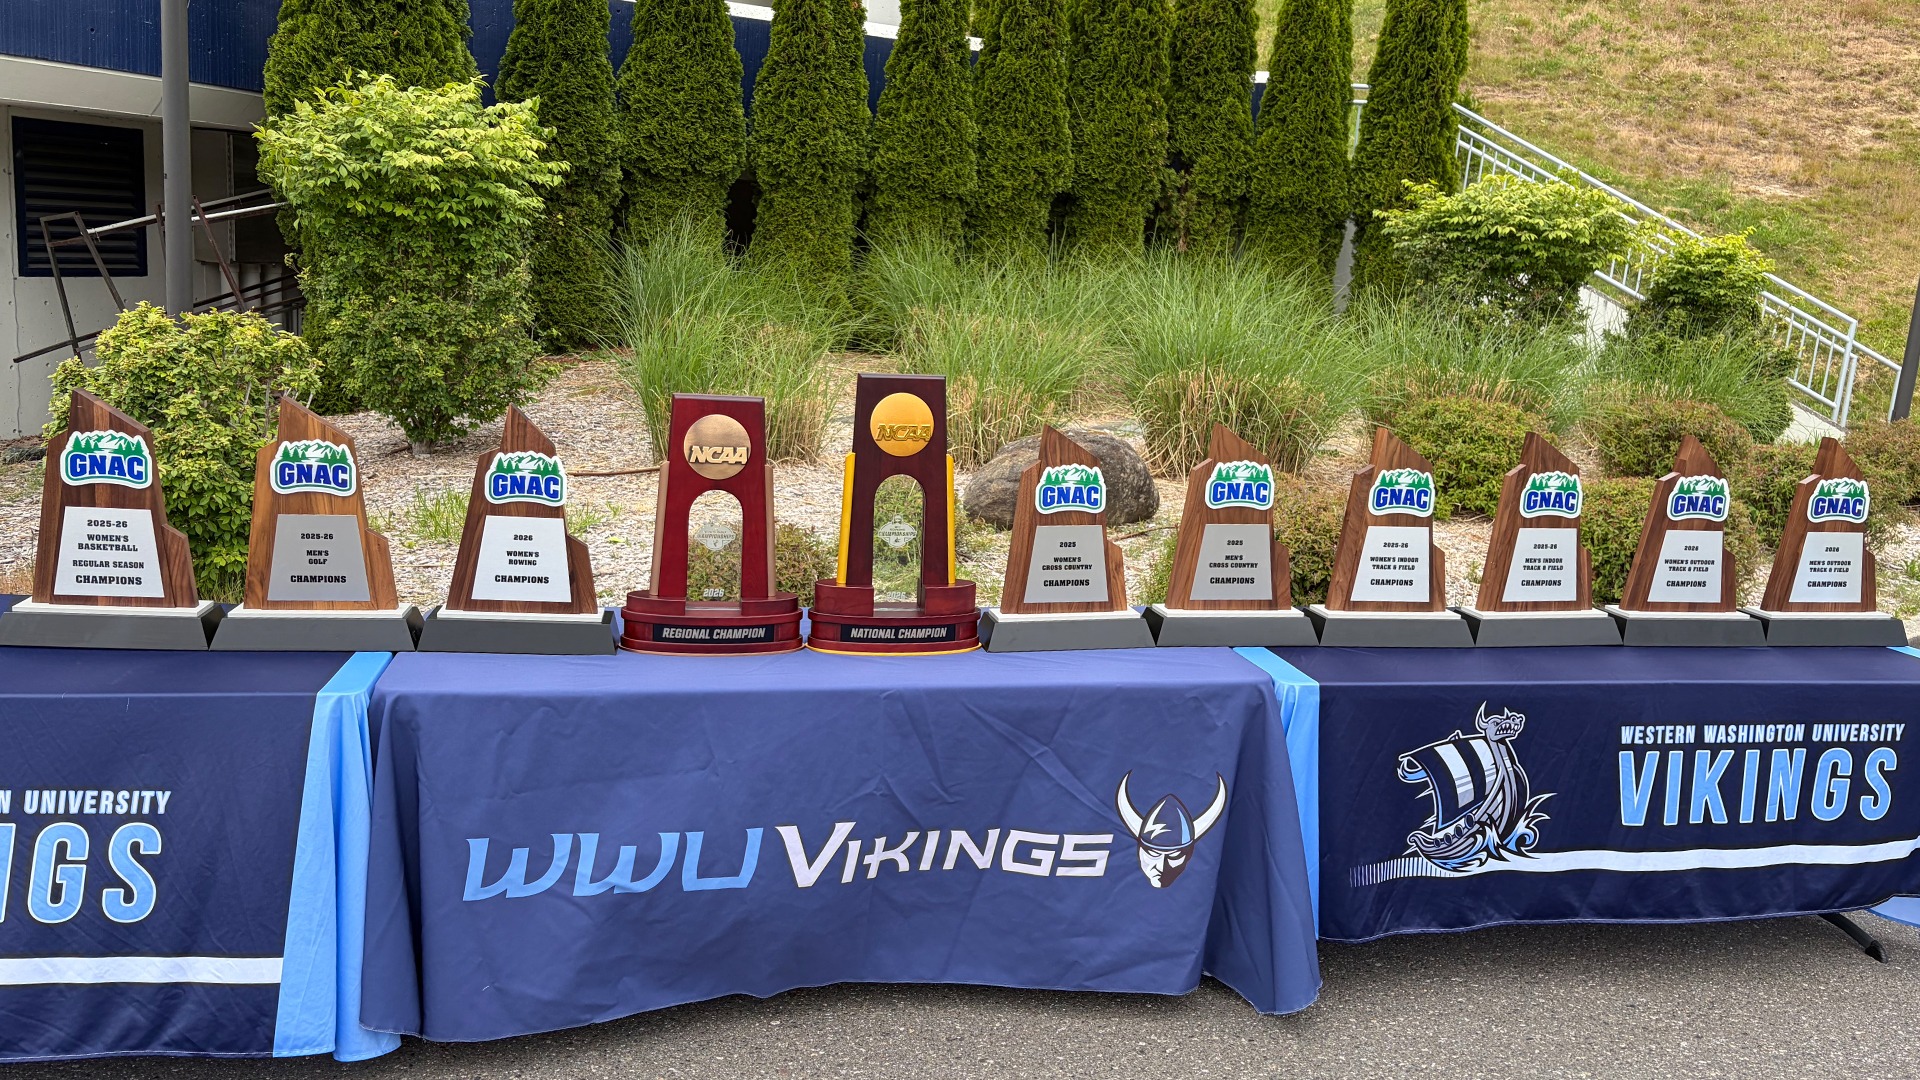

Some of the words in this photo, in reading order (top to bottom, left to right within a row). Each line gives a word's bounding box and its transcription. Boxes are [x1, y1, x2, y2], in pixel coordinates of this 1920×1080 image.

[875, 423, 932, 442] NCAA
[689, 445, 748, 465] NCAA
[69, 453, 145, 481] GNAC
[278, 463, 348, 488] GNAC
[492, 474, 560, 499] GNAC
[1212, 482, 1269, 503] GNAC
[1042, 486, 1099, 508] GNAC
[1375, 488, 1429, 509] GNAC
[1526, 491, 1576, 512] GNAC
[1673, 495, 1724, 515] GNAC
[1813, 497, 1864, 517] GNAC
[86, 519, 128, 528] 2025-26
[86, 533, 129, 543] WOMEN'S
[77, 542, 138, 552] BASKETBALL
[506, 550, 540, 558] WOMEN'S
[72, 559, 110, 568] REGULAR
[112, 560, 145, 569] SEASON
[75, 575, 143, 586] CHAMPIONS
[290, 575, 347, 584] CHAMPIONS
[494, 574, 550, 584] CHAMPIONS
[1043, 579, 1090, 587] CHAMPIONS
[1370, 578, 1414, 586] CHAMPIONS
[1521, 579, 1562, 587] CHAMPIONS
[1666, 580, 1707, 588] CHAMPIONS
[1807, 580, 1847, 588] CHAMPIONS
[703, 588, 725, 598] 2026
[662, 627, 710, 640] REGIONAL
[712, 627, 766, 640] CHAMPION
[850, 626, 897, 640] NATIONAL
[898, 626, 948, 640] CHAMPION
[1621, 725, 1696, 745] WESTERN
[1703, 723, 1805, 744] WASHINGTON
[1811, 723, 1905, 742] UNIVERSITY
[1618, 747, 1897, 826] VIKINGS
[23, 789, 172, 815] UNIVERSITY
[462, 827, 764, 902] WWU
[774, 820, 1114, 889] VIKINGS
